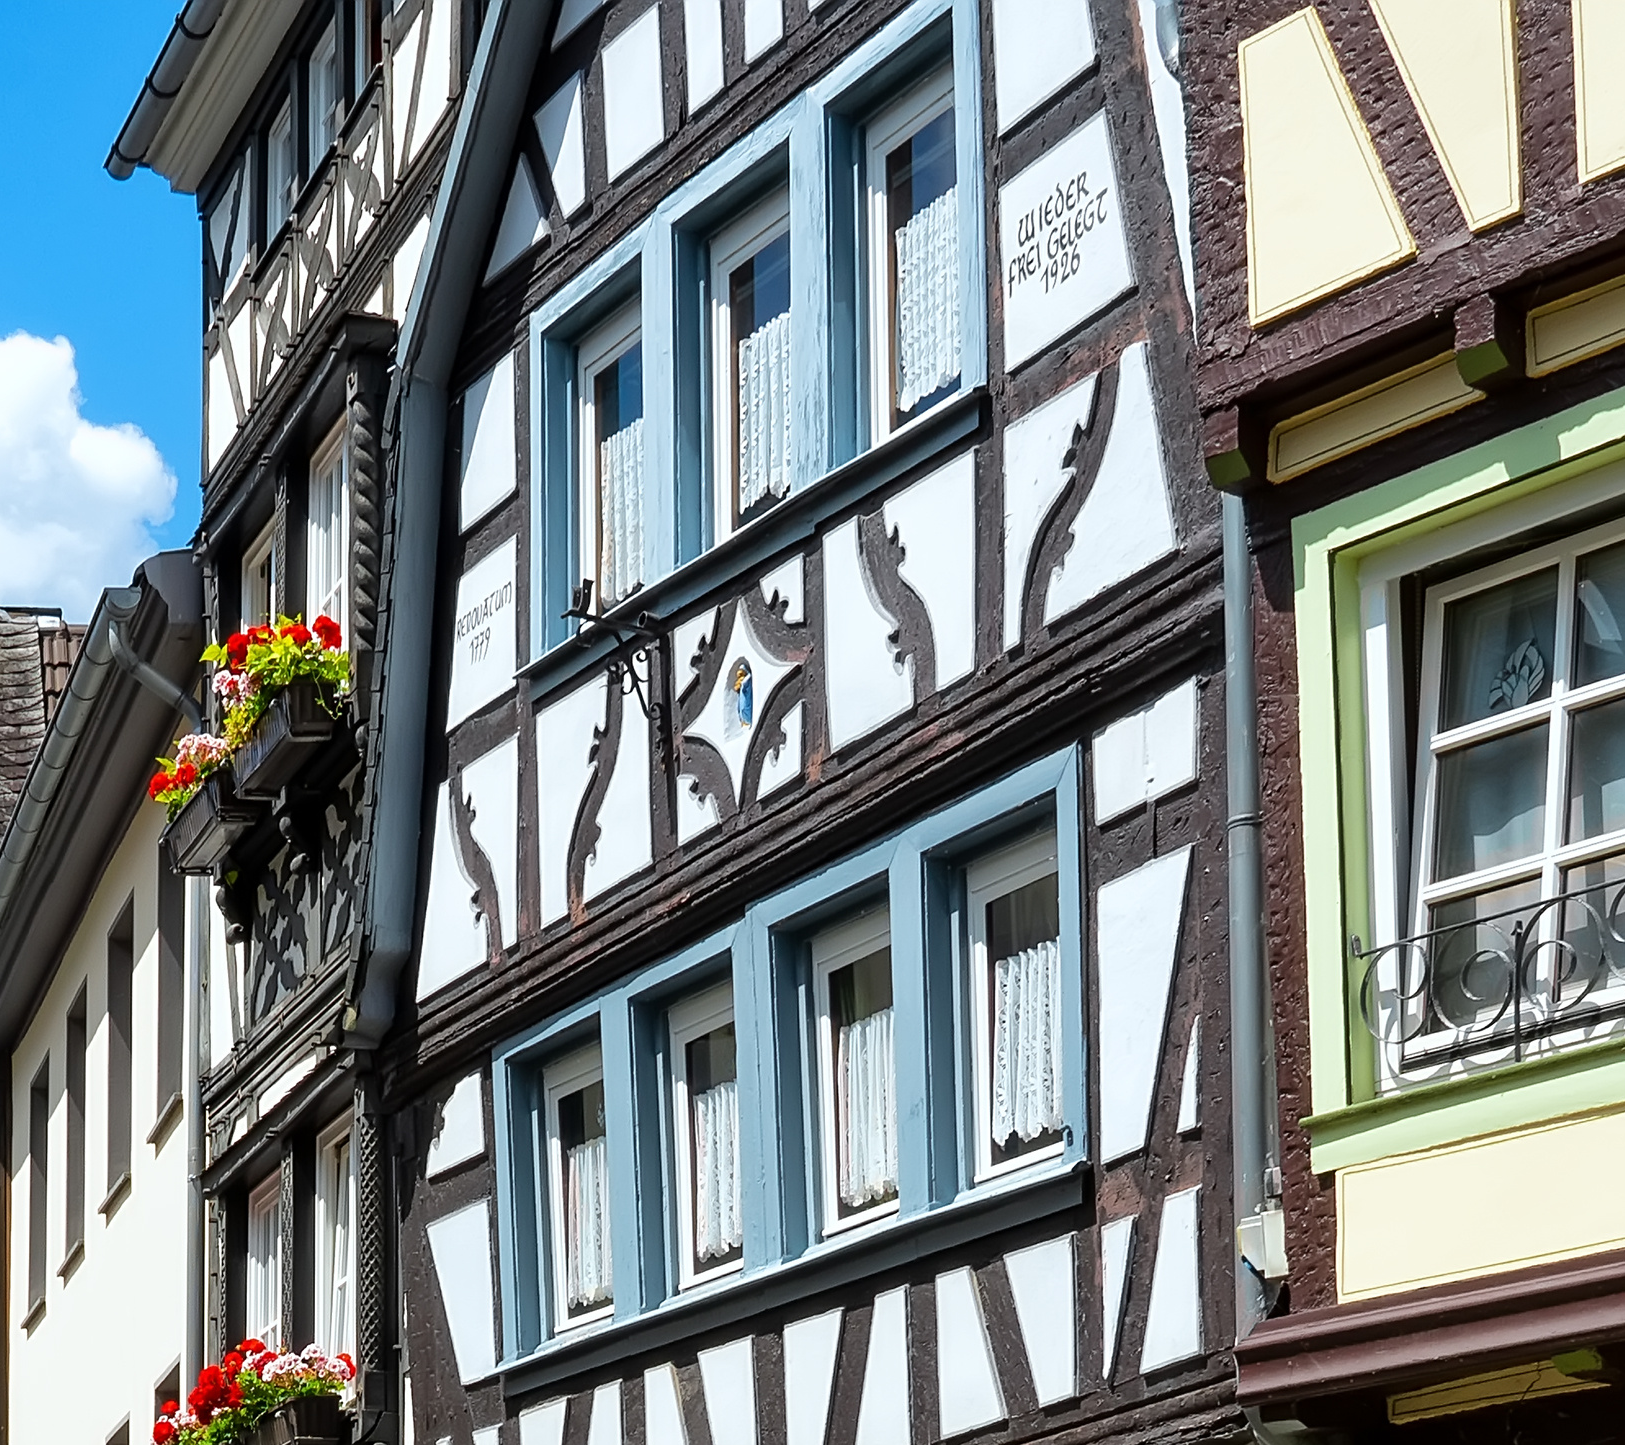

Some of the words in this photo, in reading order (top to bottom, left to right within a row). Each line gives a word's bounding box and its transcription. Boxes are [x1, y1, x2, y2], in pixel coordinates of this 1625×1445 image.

[1018, 171, 1089, 248] WIEDER
[1008, 241, 1042, 299] FREI
[1047, 187, 1108, 260] GELEGT
[1040, 243, 1081, 294] 1926
[469, 626, 491, 665] 1779
